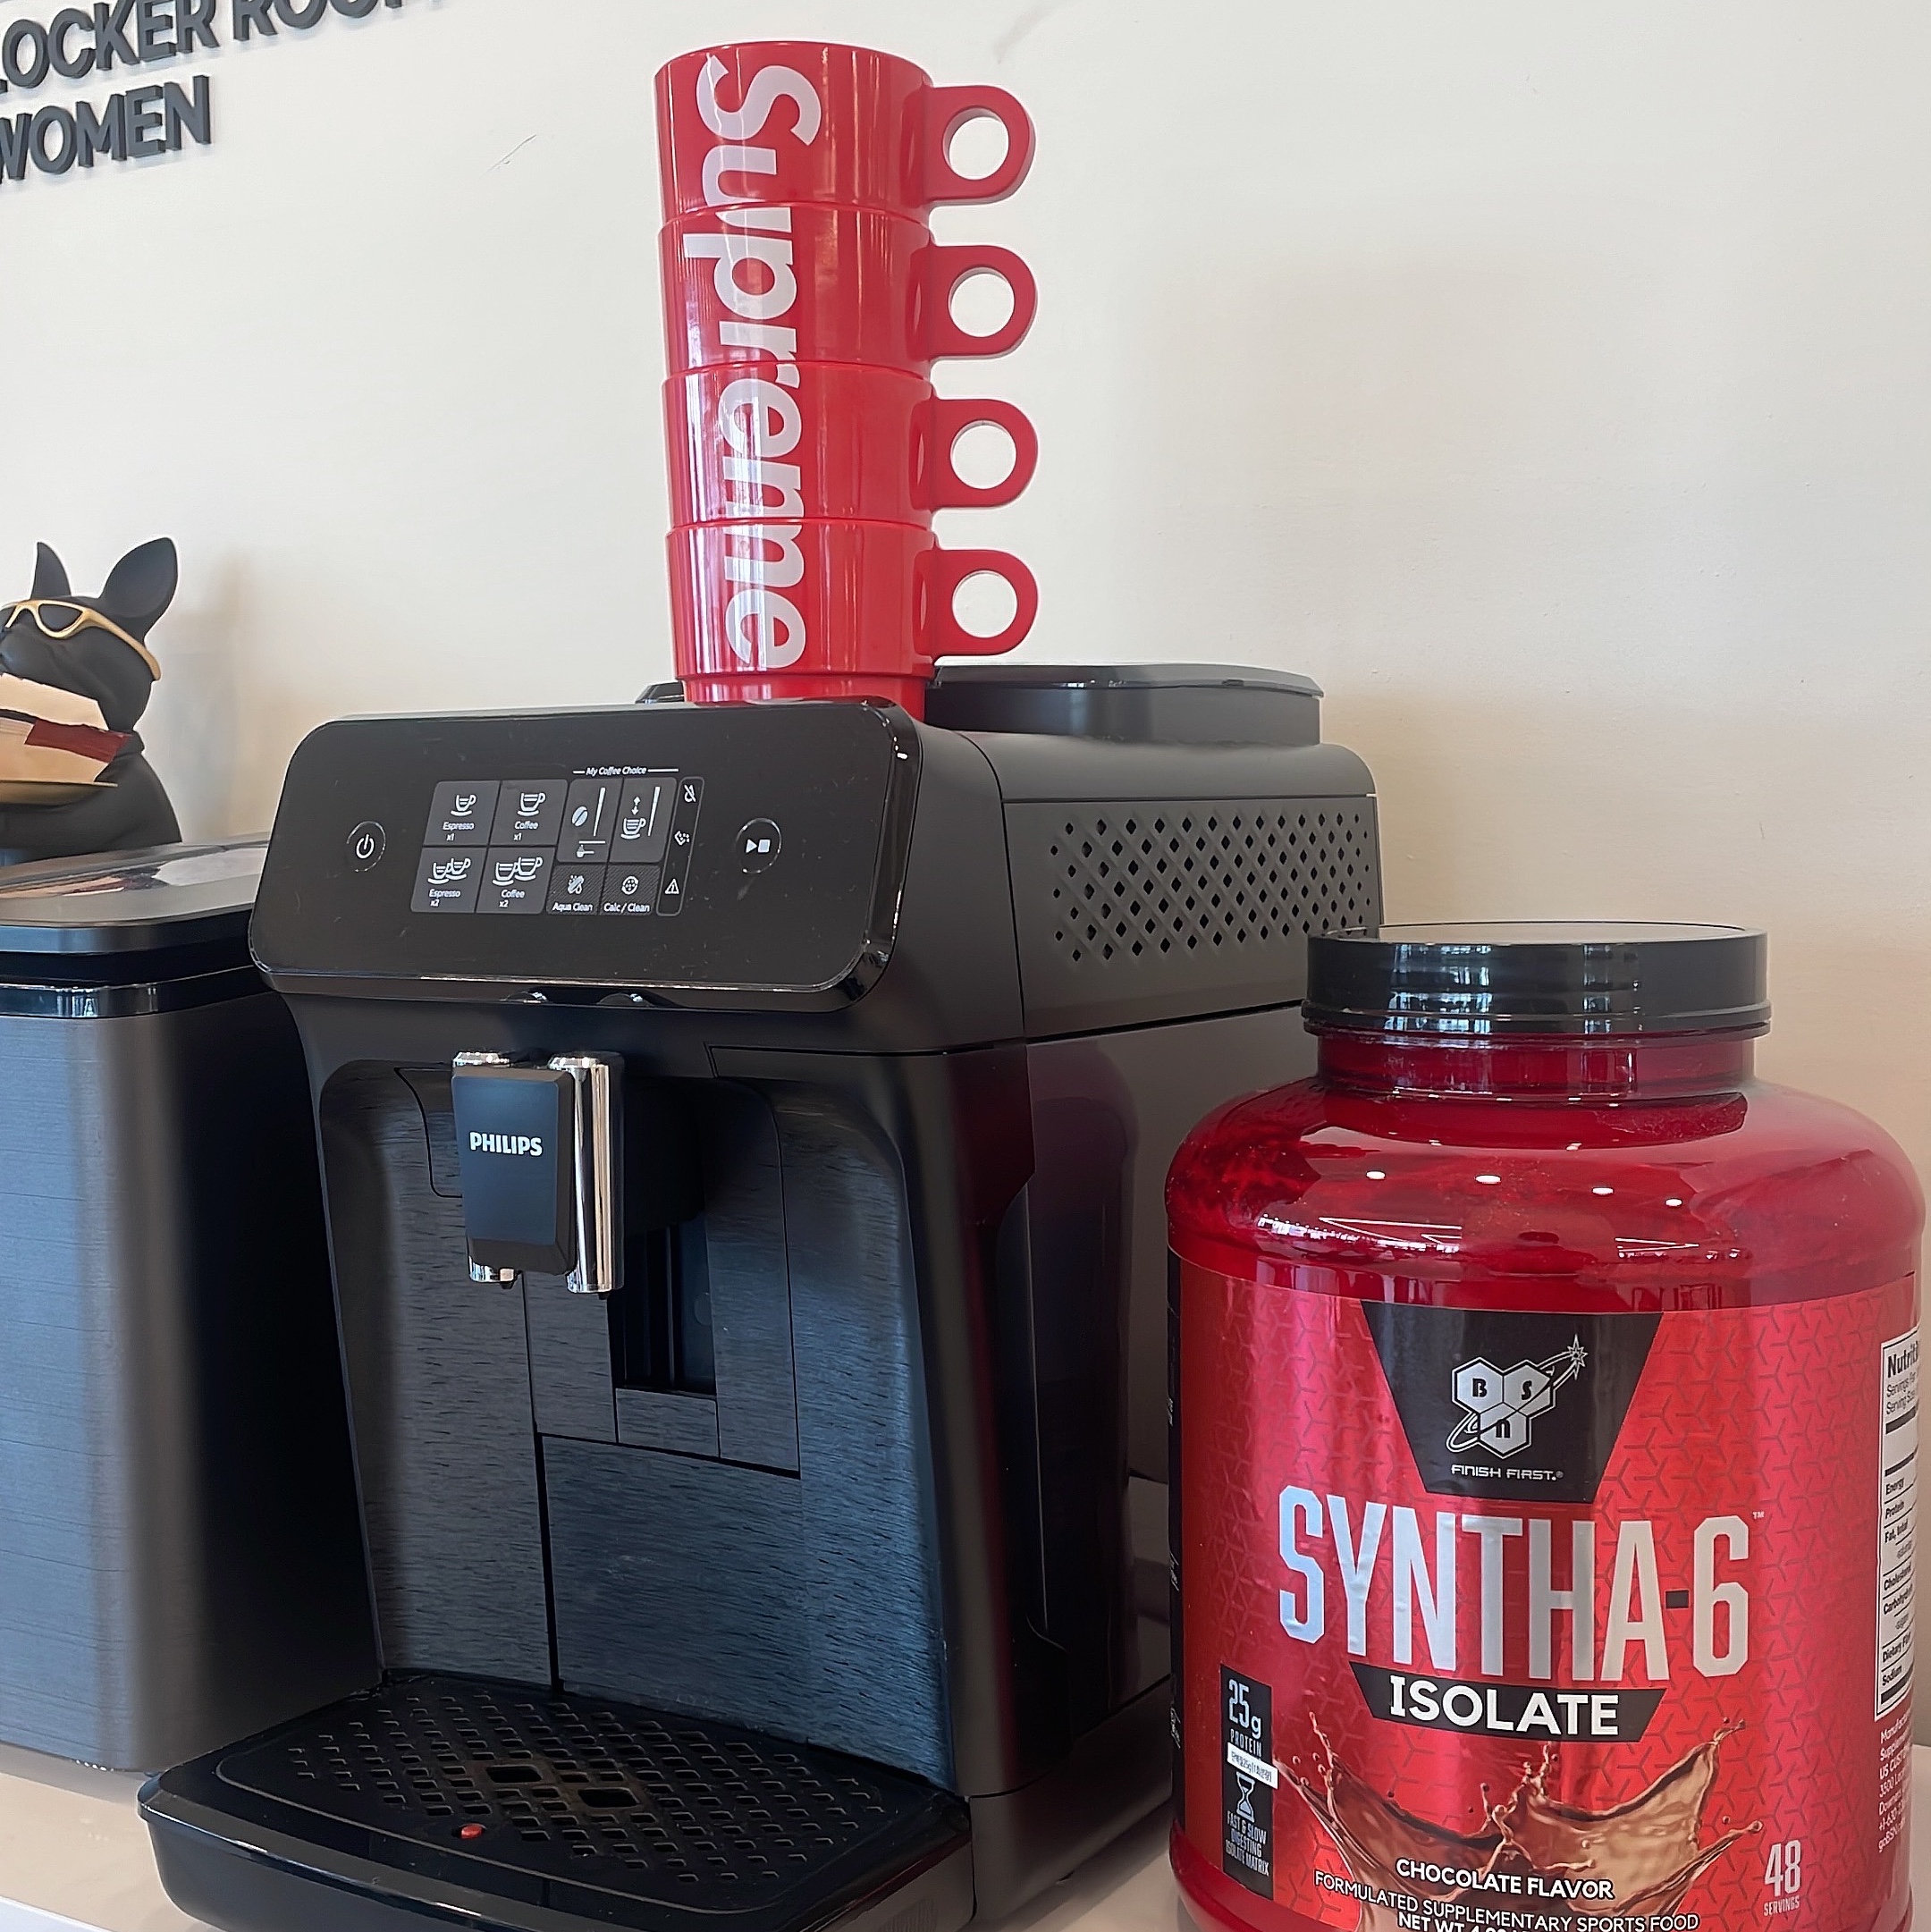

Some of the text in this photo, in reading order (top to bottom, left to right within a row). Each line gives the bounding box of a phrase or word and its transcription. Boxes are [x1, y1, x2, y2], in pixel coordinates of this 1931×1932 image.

[0, 0, 220, 95] OCKER
[683, 55, 822, 670] Supreme
[586, 766, 647, 777] My Coffee Choice
[443, 822, 475, 831] Espresso
[514, 821, 538, 830] Coffee
[446, 833, 455, 841] x1
[513, 833, 522, 841] x1
[429, 889, 461, 899] Espresso
[430, 899, 440, 907] x2
[499, 899, 509, 908] x2
[501, 889, 526, 899] Coffee
[552, 902, 593, 913] Aqua Clean
[603, 903, 620, 913] Calc
[628, 902, 650, 912] Clean
[469, 1131, 543, 1157] PHILIPS
[1451, 1464, 1502, 1479] FINISH
[1278, 1484, 1749, 1682] SYNTHA-6
[1388, 1675, 1620, 1737] ISOLATE
[1230, 1728, 1262, 1758] PROTEIN
[1227, 1810, 1267, 1844] FAST & SLOW
[1231, 1828, 1262, 1858] DIGESTING
[1226, 1839, 1269, 1877] ISOLATE MATRIX
[1764, 1840, 1802, 1897] 48
[1396, 1858, 1615, 1899] CHOCOLATE FLAVOR
[1314, 1870, 1699, 1932] FORMULATED SUPPLEMENTARY SPORTS FOOD
[1764, 1896, 1800, 1917] SERVINGS
[1398, 1911, 1431, 1932] NET
